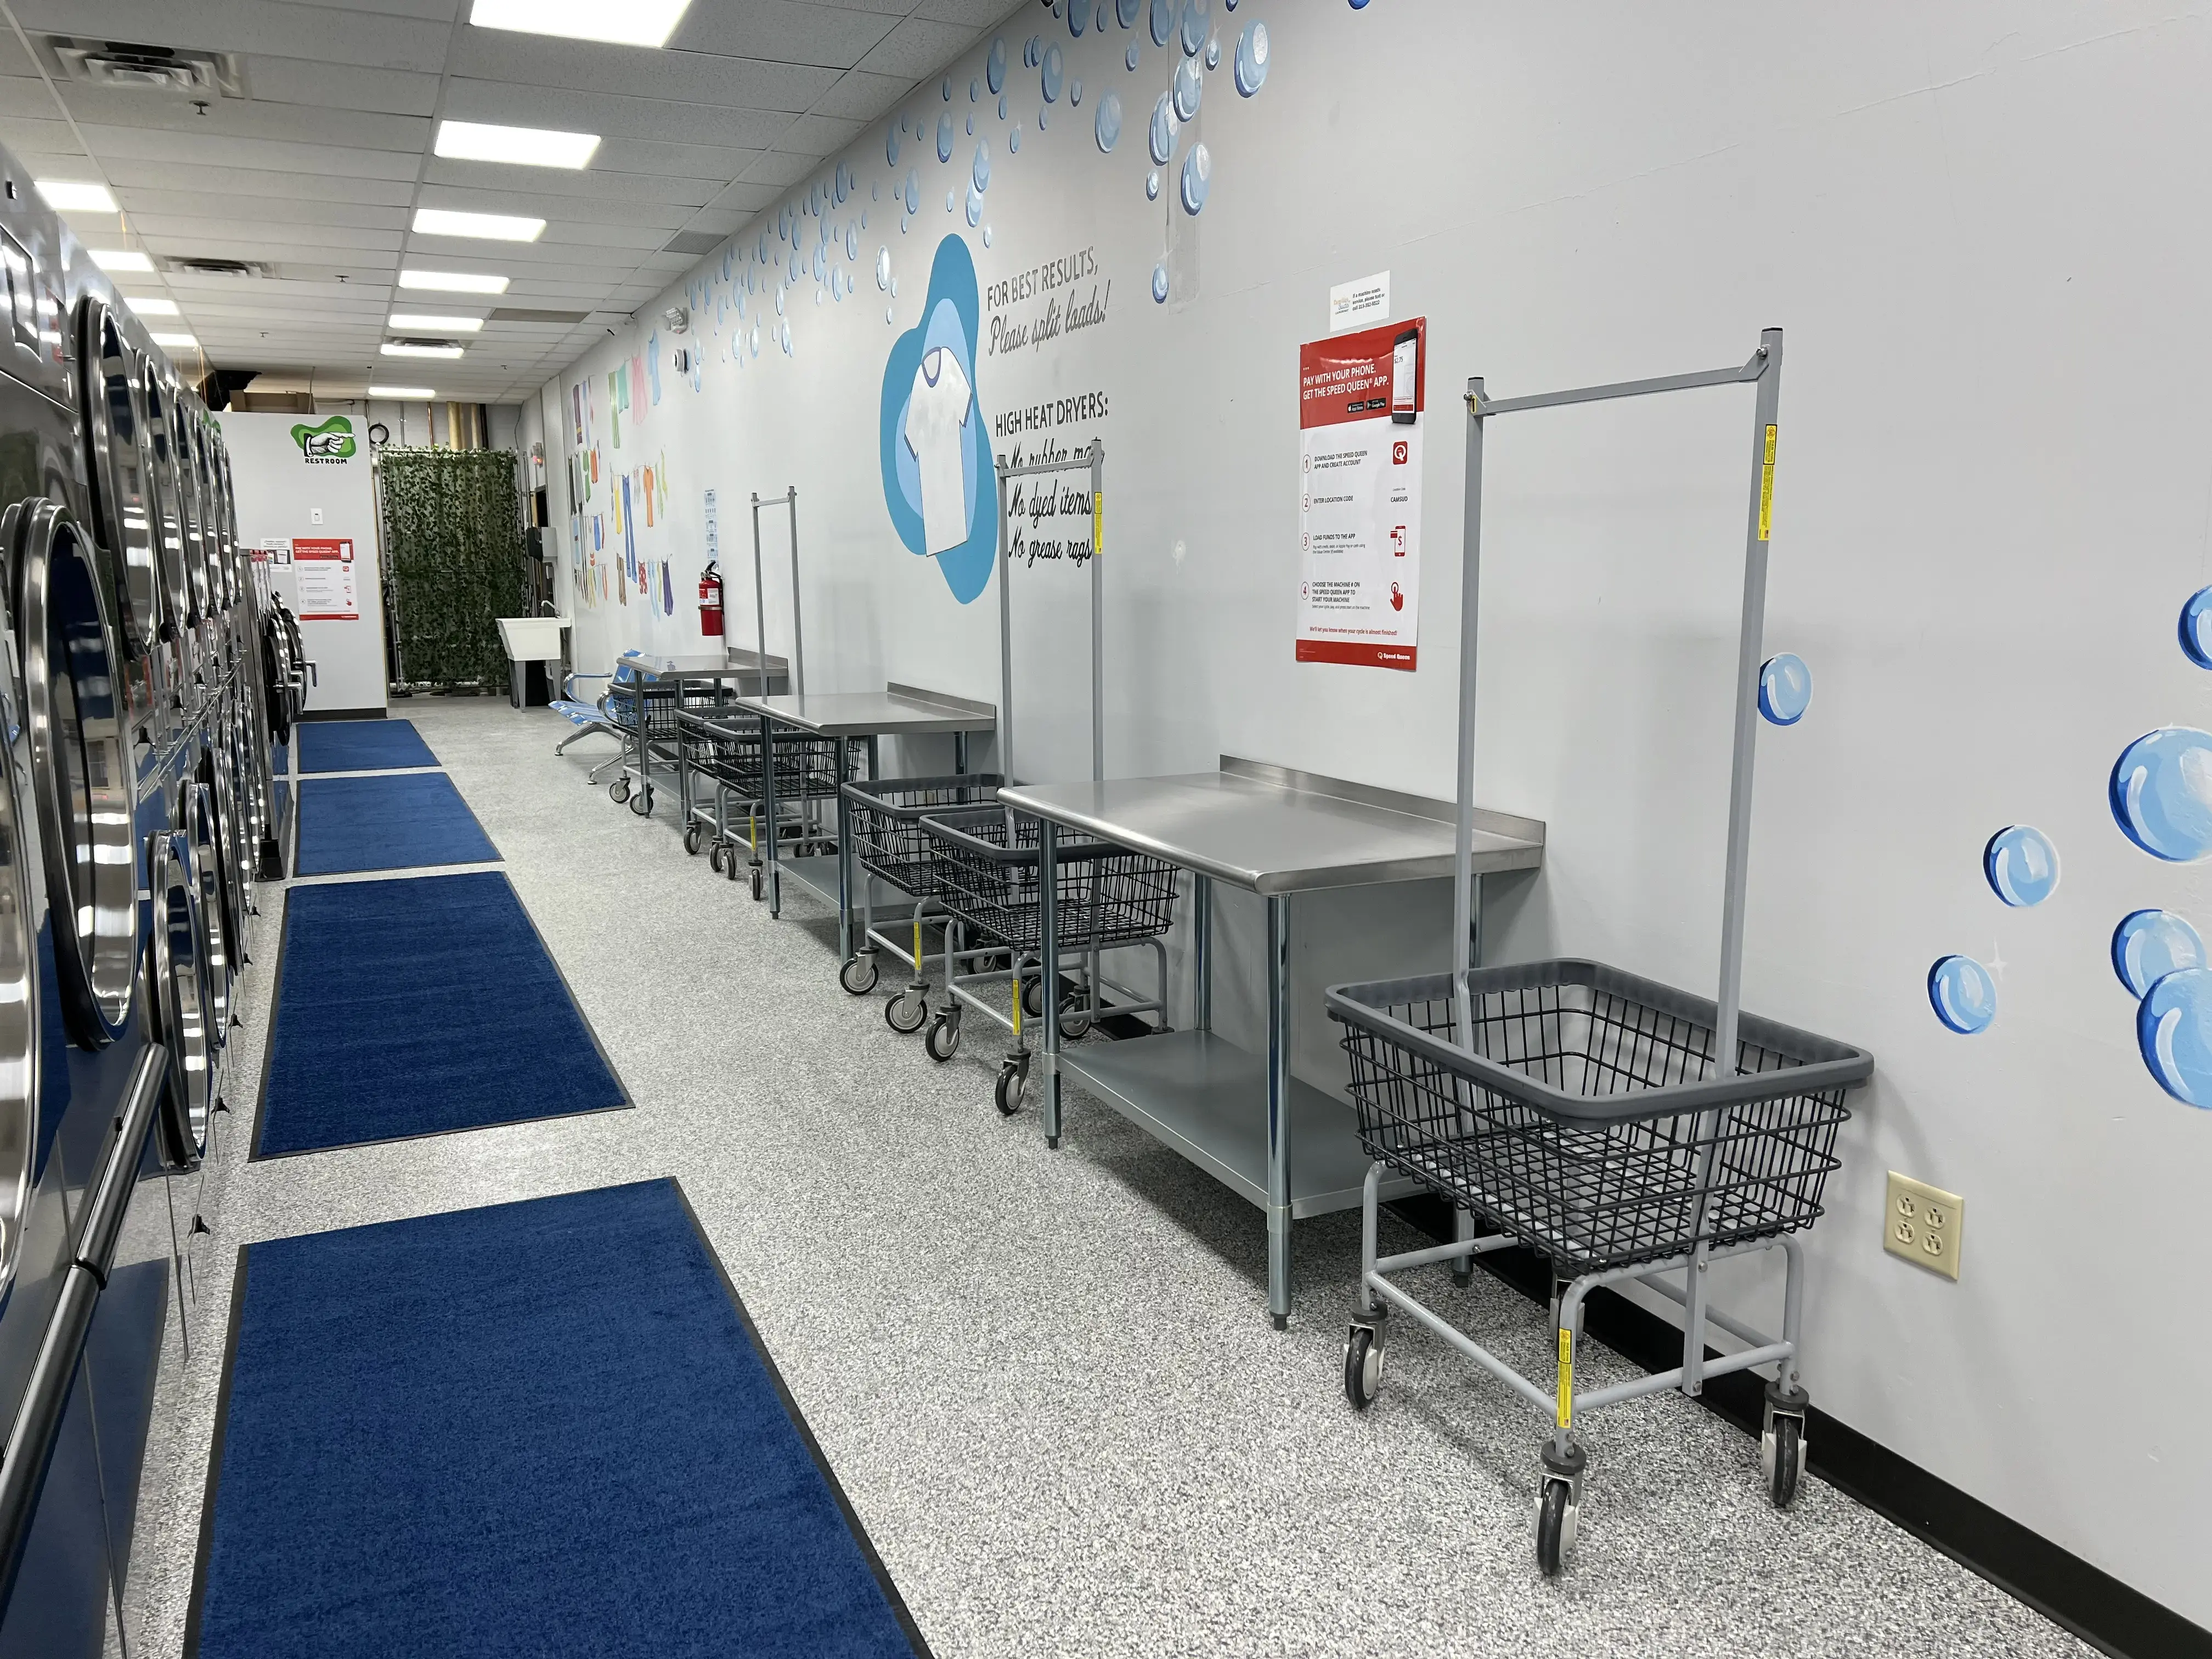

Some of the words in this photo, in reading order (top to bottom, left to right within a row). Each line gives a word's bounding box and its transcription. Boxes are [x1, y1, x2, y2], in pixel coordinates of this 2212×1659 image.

[988, 280, 1009, 311] FOR
[1012, 269, 1038, 303] BEST
[1042, 246, 1098, 291] RESULTS,
[989, 314, 1028, 356] Please
[1031, 297, 1061, 352] split
[1065, 279, 1110, 333] loads!
[1304, 377, 1314, 387] PAY
[1315, 372, 1331, 385] WITH
[1332, 369, 1350, 381] YOUR
[1351, 363, 1376, 377] PHONE.
[1304, 390, 1313, 400] GET
[1314, 387, 1326, 398] THE
[1327, 383, 1345, 396] SPEED
[1374, 375, 1389, 388] APP.
[996, 410, 1022, 437] HIGH
[1025, 403, 1053, 430] HEAT
[1057, 391, 1108, 425] DRYERS:
[1008, 482, 1025, 517] No
[1029, 479, 1058, 529] dyed
[1060, 486, 1092, 515] items
[1008, 526, 1025, 558] No
[1029, 538, 1063, 568] grease
[1066, 538, 1092, 568] rags
